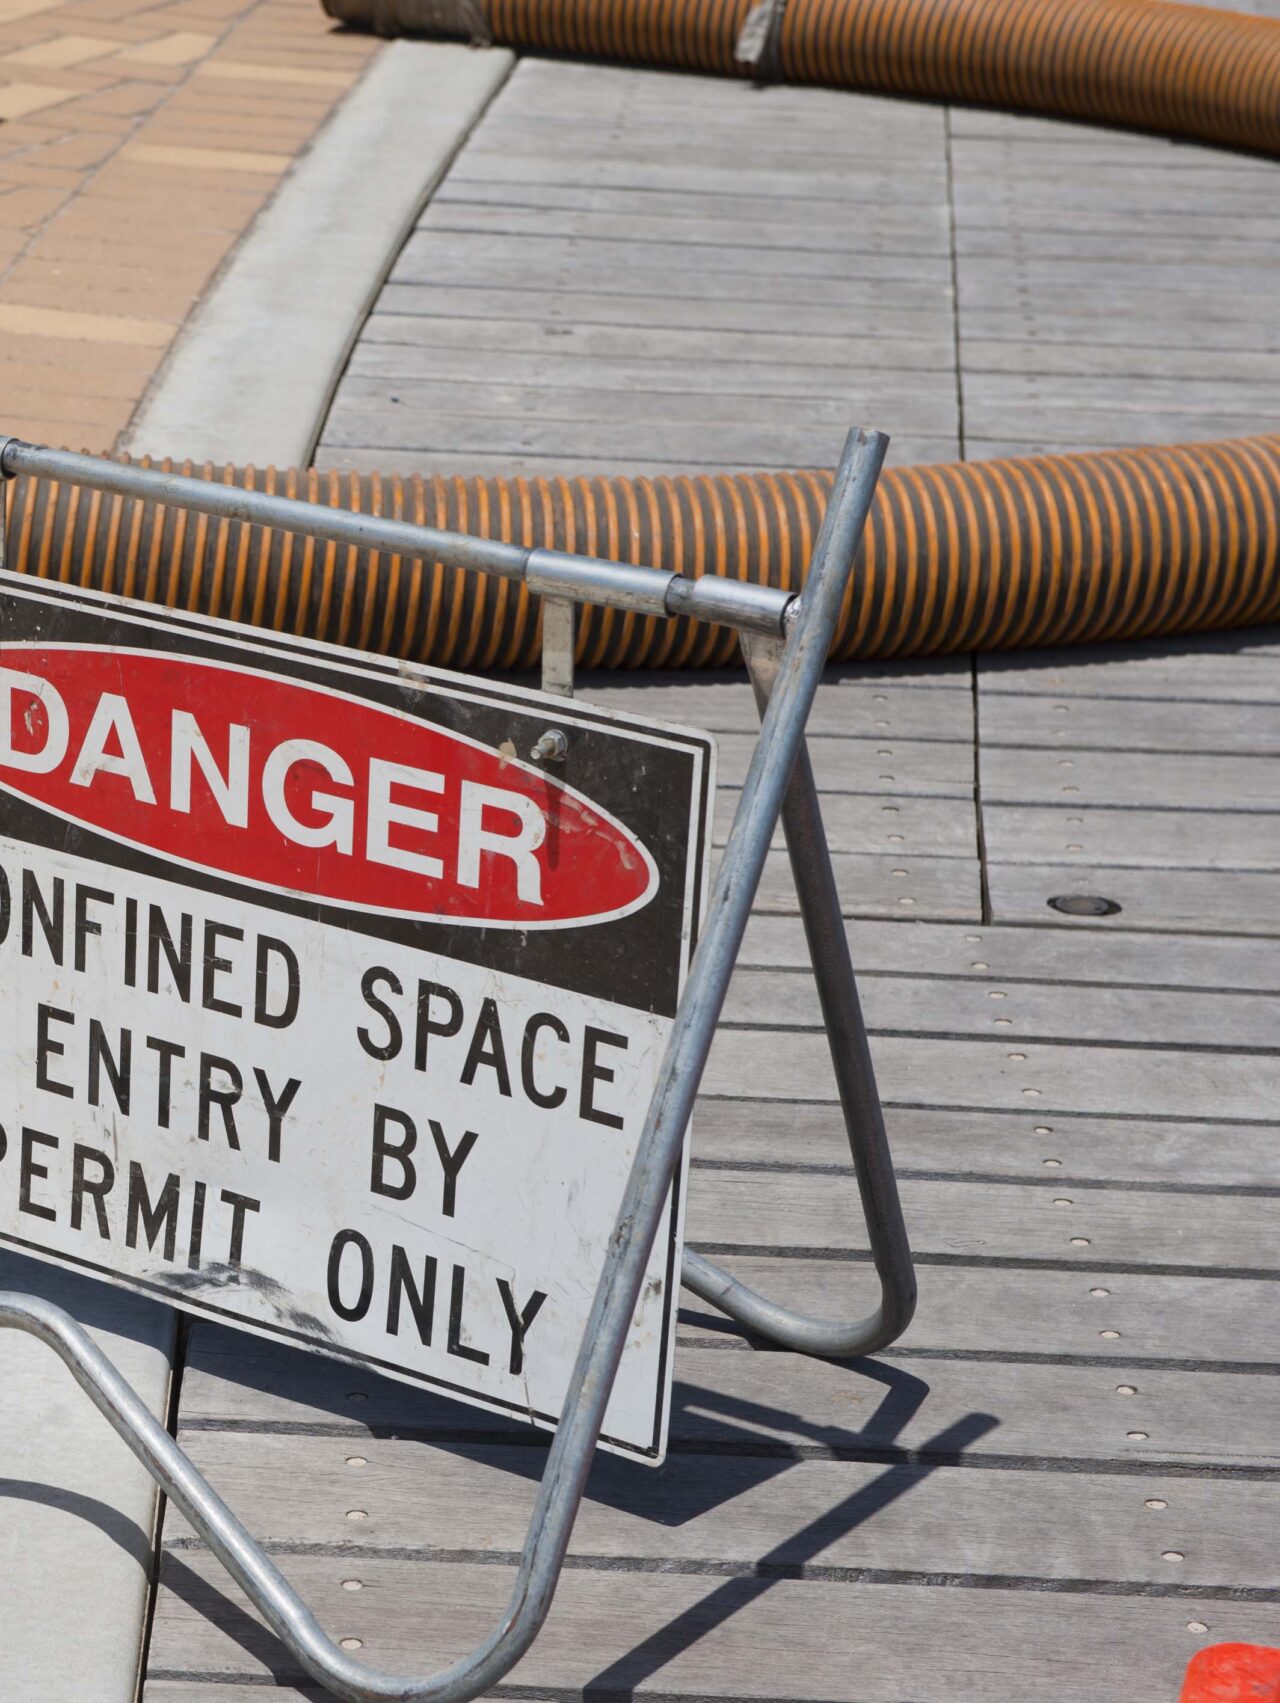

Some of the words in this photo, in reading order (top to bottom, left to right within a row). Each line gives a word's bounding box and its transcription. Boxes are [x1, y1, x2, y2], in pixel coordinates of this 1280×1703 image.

[36, 1003, 302, 1163] ENTRY
[370, 1103, 478, 1217] BY
[356, 965, 629, 1131] SPACE
[327, 1228, 548, 1375] ONLY
